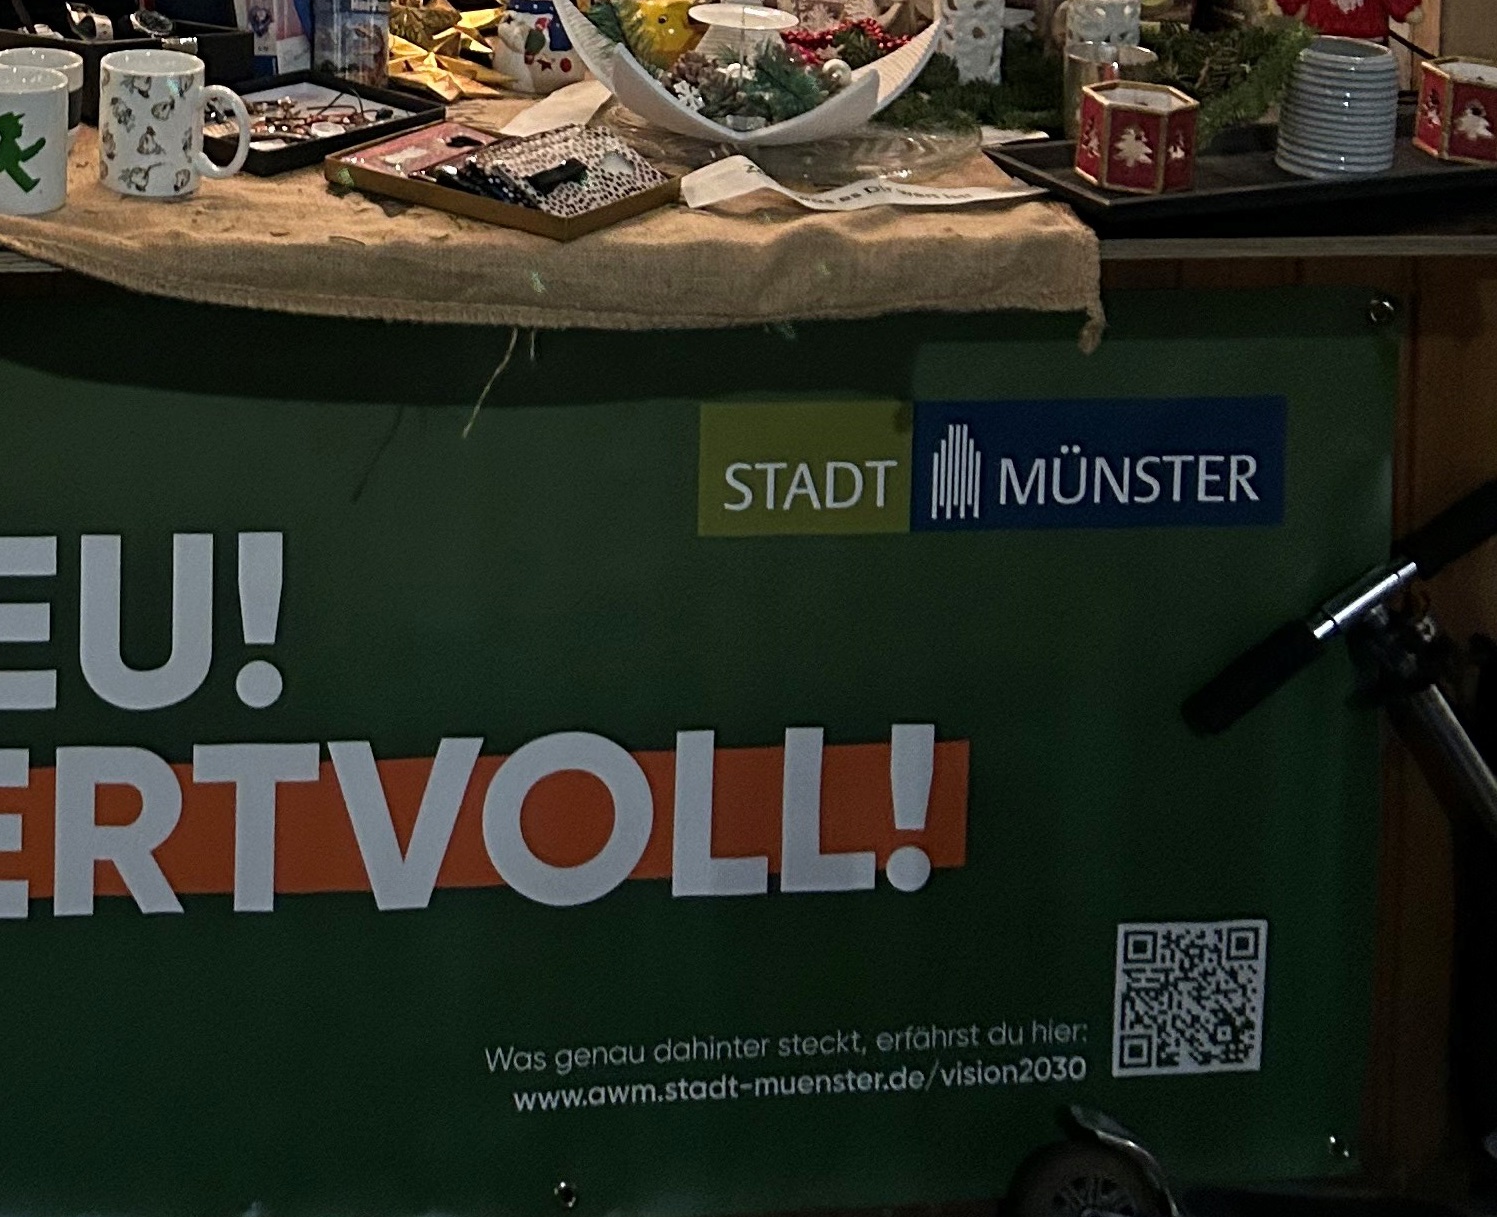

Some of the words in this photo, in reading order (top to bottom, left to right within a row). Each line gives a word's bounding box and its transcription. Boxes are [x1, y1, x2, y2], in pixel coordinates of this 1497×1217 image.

[723, 460, 898, 511] STADT
[1000, 445, 1260, 505] MÜNSTER
[485, 1046, 547, 1072] Was
[554, 1044, 645, 1076] genau
[654, 1035, 770, 1064] dahinter
[777, 1029, 867, 1057] steckt,
[876, 1023, 980, 1052] erfährst
[987, 1022, 1024, 1046] du
[1031, 1018, 1088, 1044] hier:
[513, 1055, 1087, 1112] www.awm.stadt-muenster.de/vision2030
